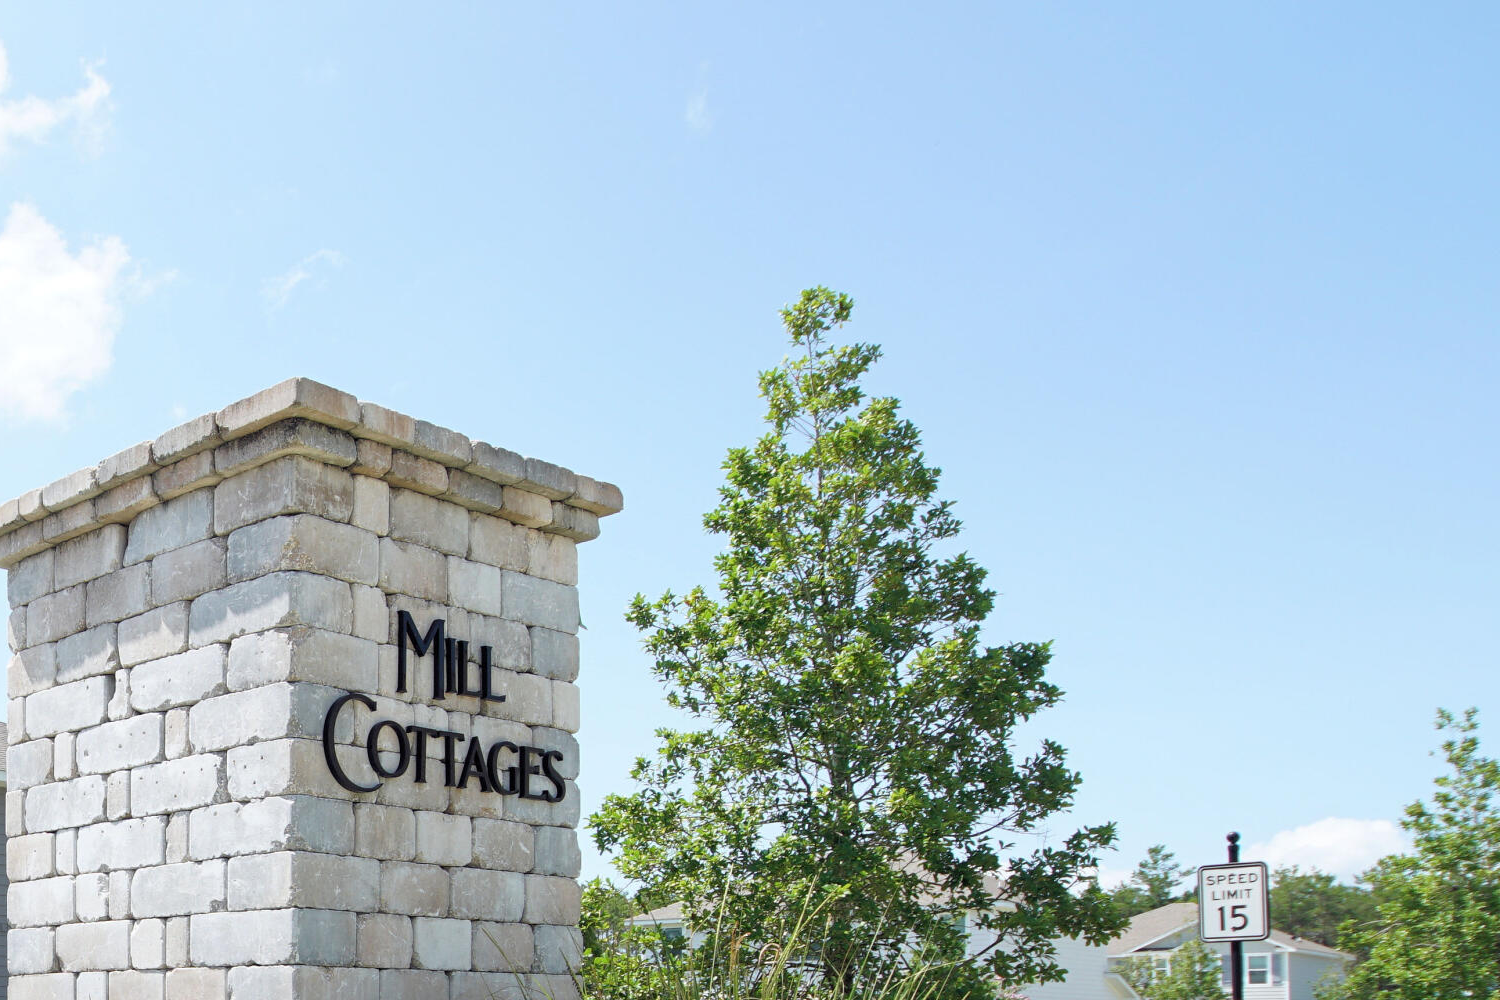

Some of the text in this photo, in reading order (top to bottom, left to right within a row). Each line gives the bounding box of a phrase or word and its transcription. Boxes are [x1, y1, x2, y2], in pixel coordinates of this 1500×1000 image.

[397, 610, 506, 702] MILL
[323, 693, 566, 803] COTTAGES
[1206, 873, 1258, 886] SPEED
[1211, 888, 1252, 901] LIMIT
[1217, 905, 1248, 932] 15
